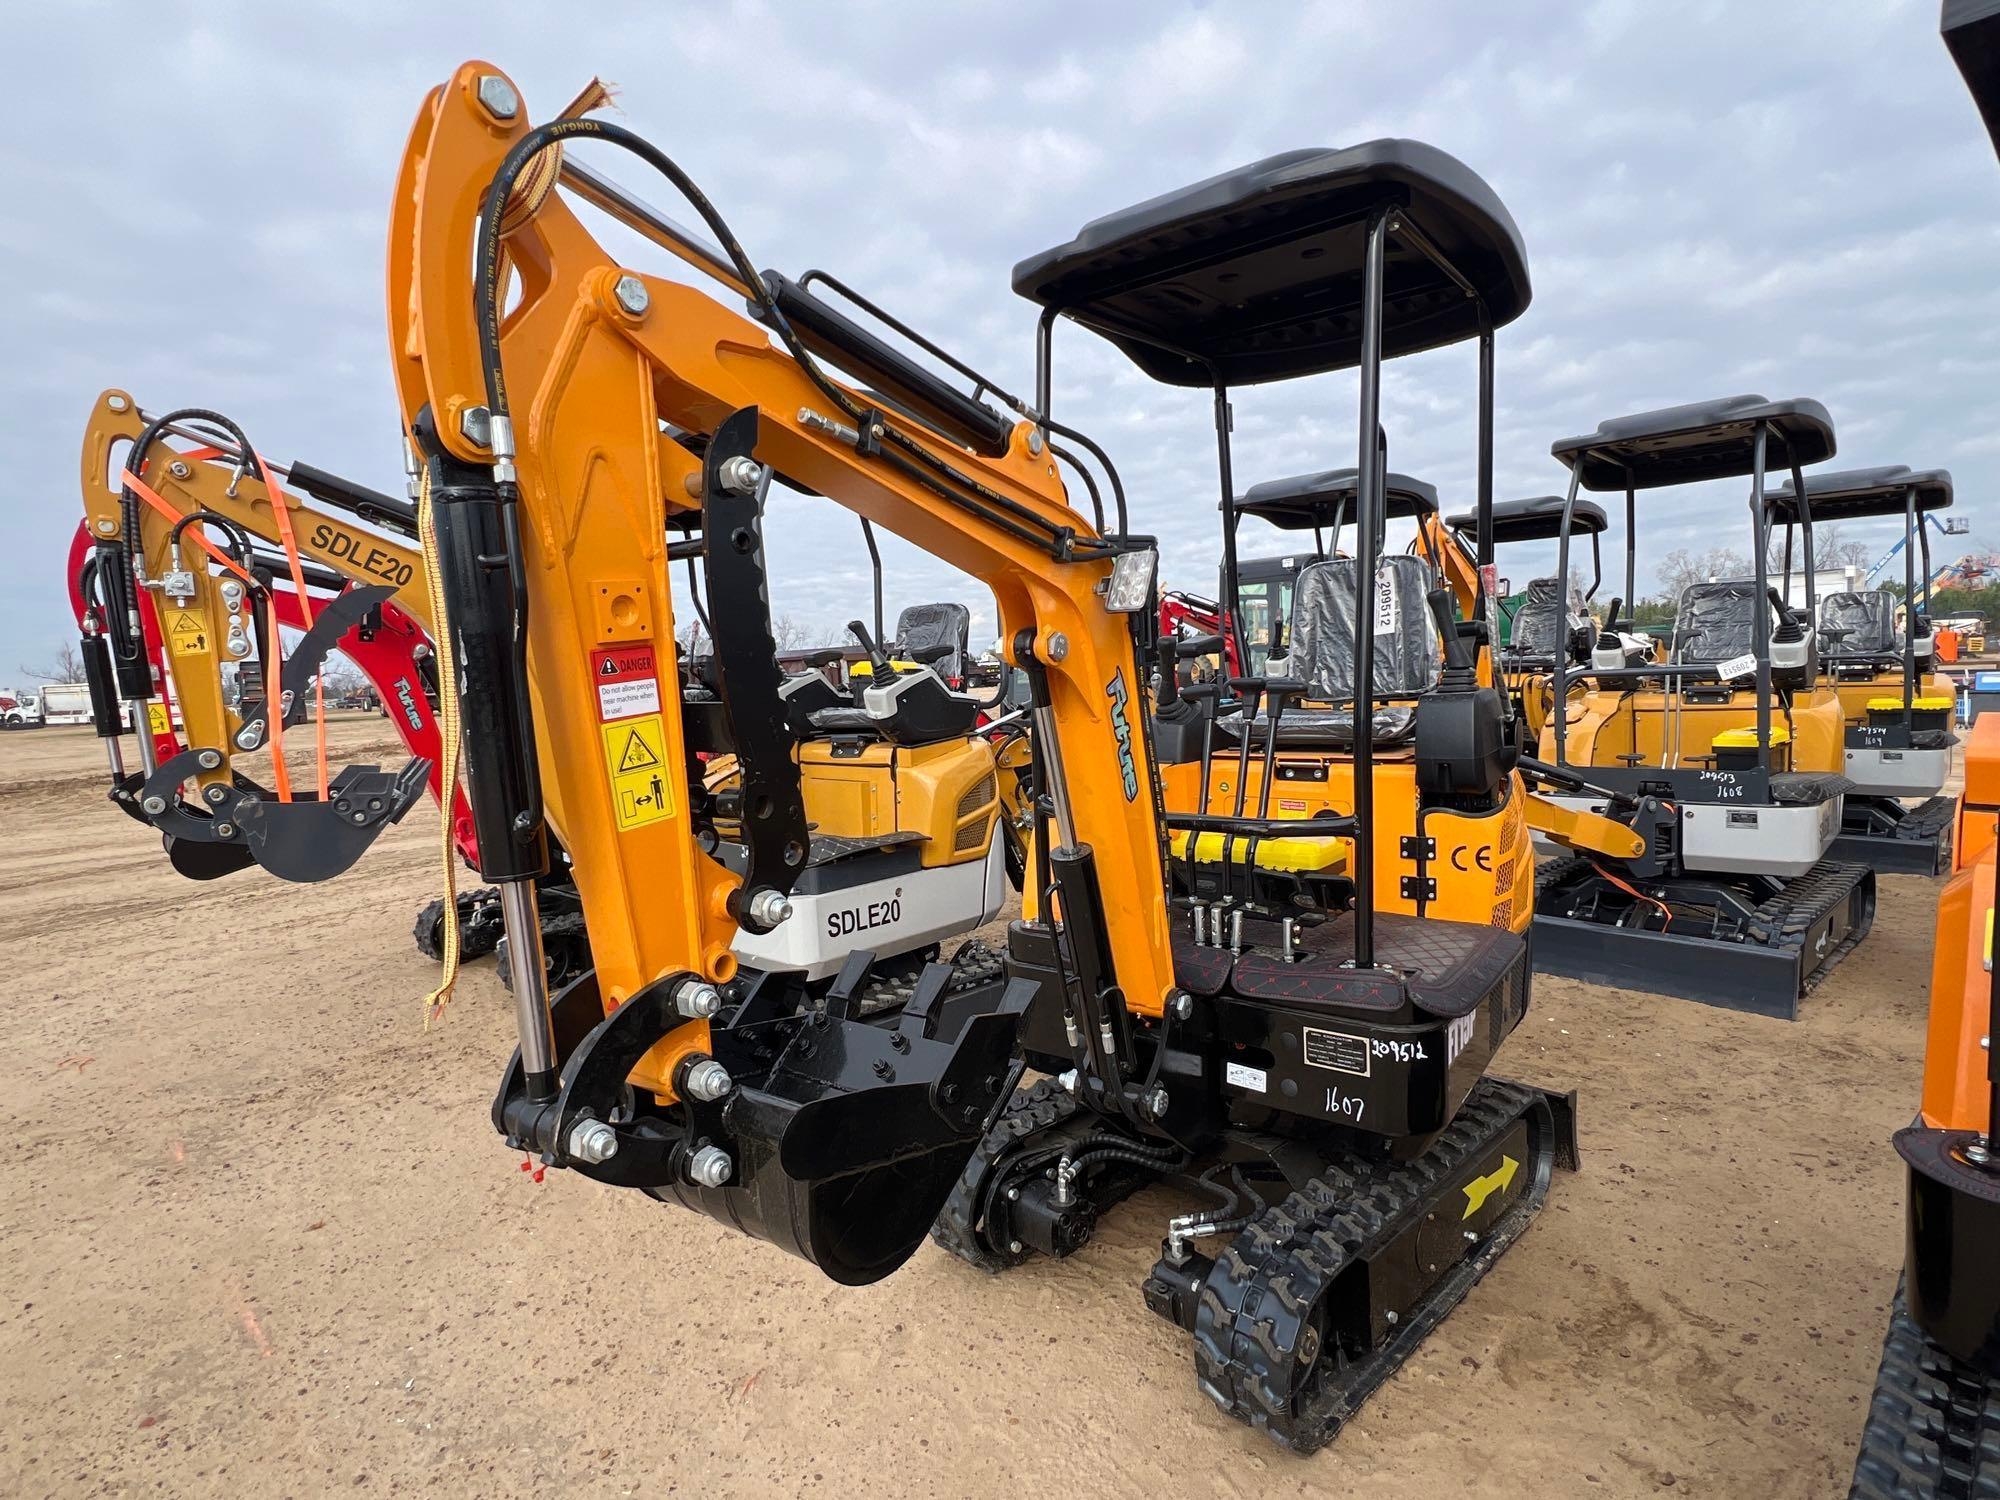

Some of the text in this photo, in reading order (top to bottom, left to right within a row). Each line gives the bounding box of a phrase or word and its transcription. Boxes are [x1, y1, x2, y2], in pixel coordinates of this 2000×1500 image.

[550, 121, 600, 136] YONGJIE
[310, 524, 413, 587] SDLE20
[1380, 581, 1392, 627] 209512
[620, 656, 652, 672] DANGER
[601, 687, 610, 695] Do
[621, 684, 636, 692] allow
[636, 681, 655, 691] people
[603, 691, 655, 705] near machine when
[393, 675, 424, 732] Future
[1106, 665, 1139, 803] Future
[1699, 770, 1736, 784] 209513
[1717, 785, 1743, 798] 1608
[1451, 845, 1493, 872] CE
[827, 898, 901, 938] SDLE20
[1370, 1037, 1429, 1062] 209512
[1325, 1086, 1365, 1122] 1607
